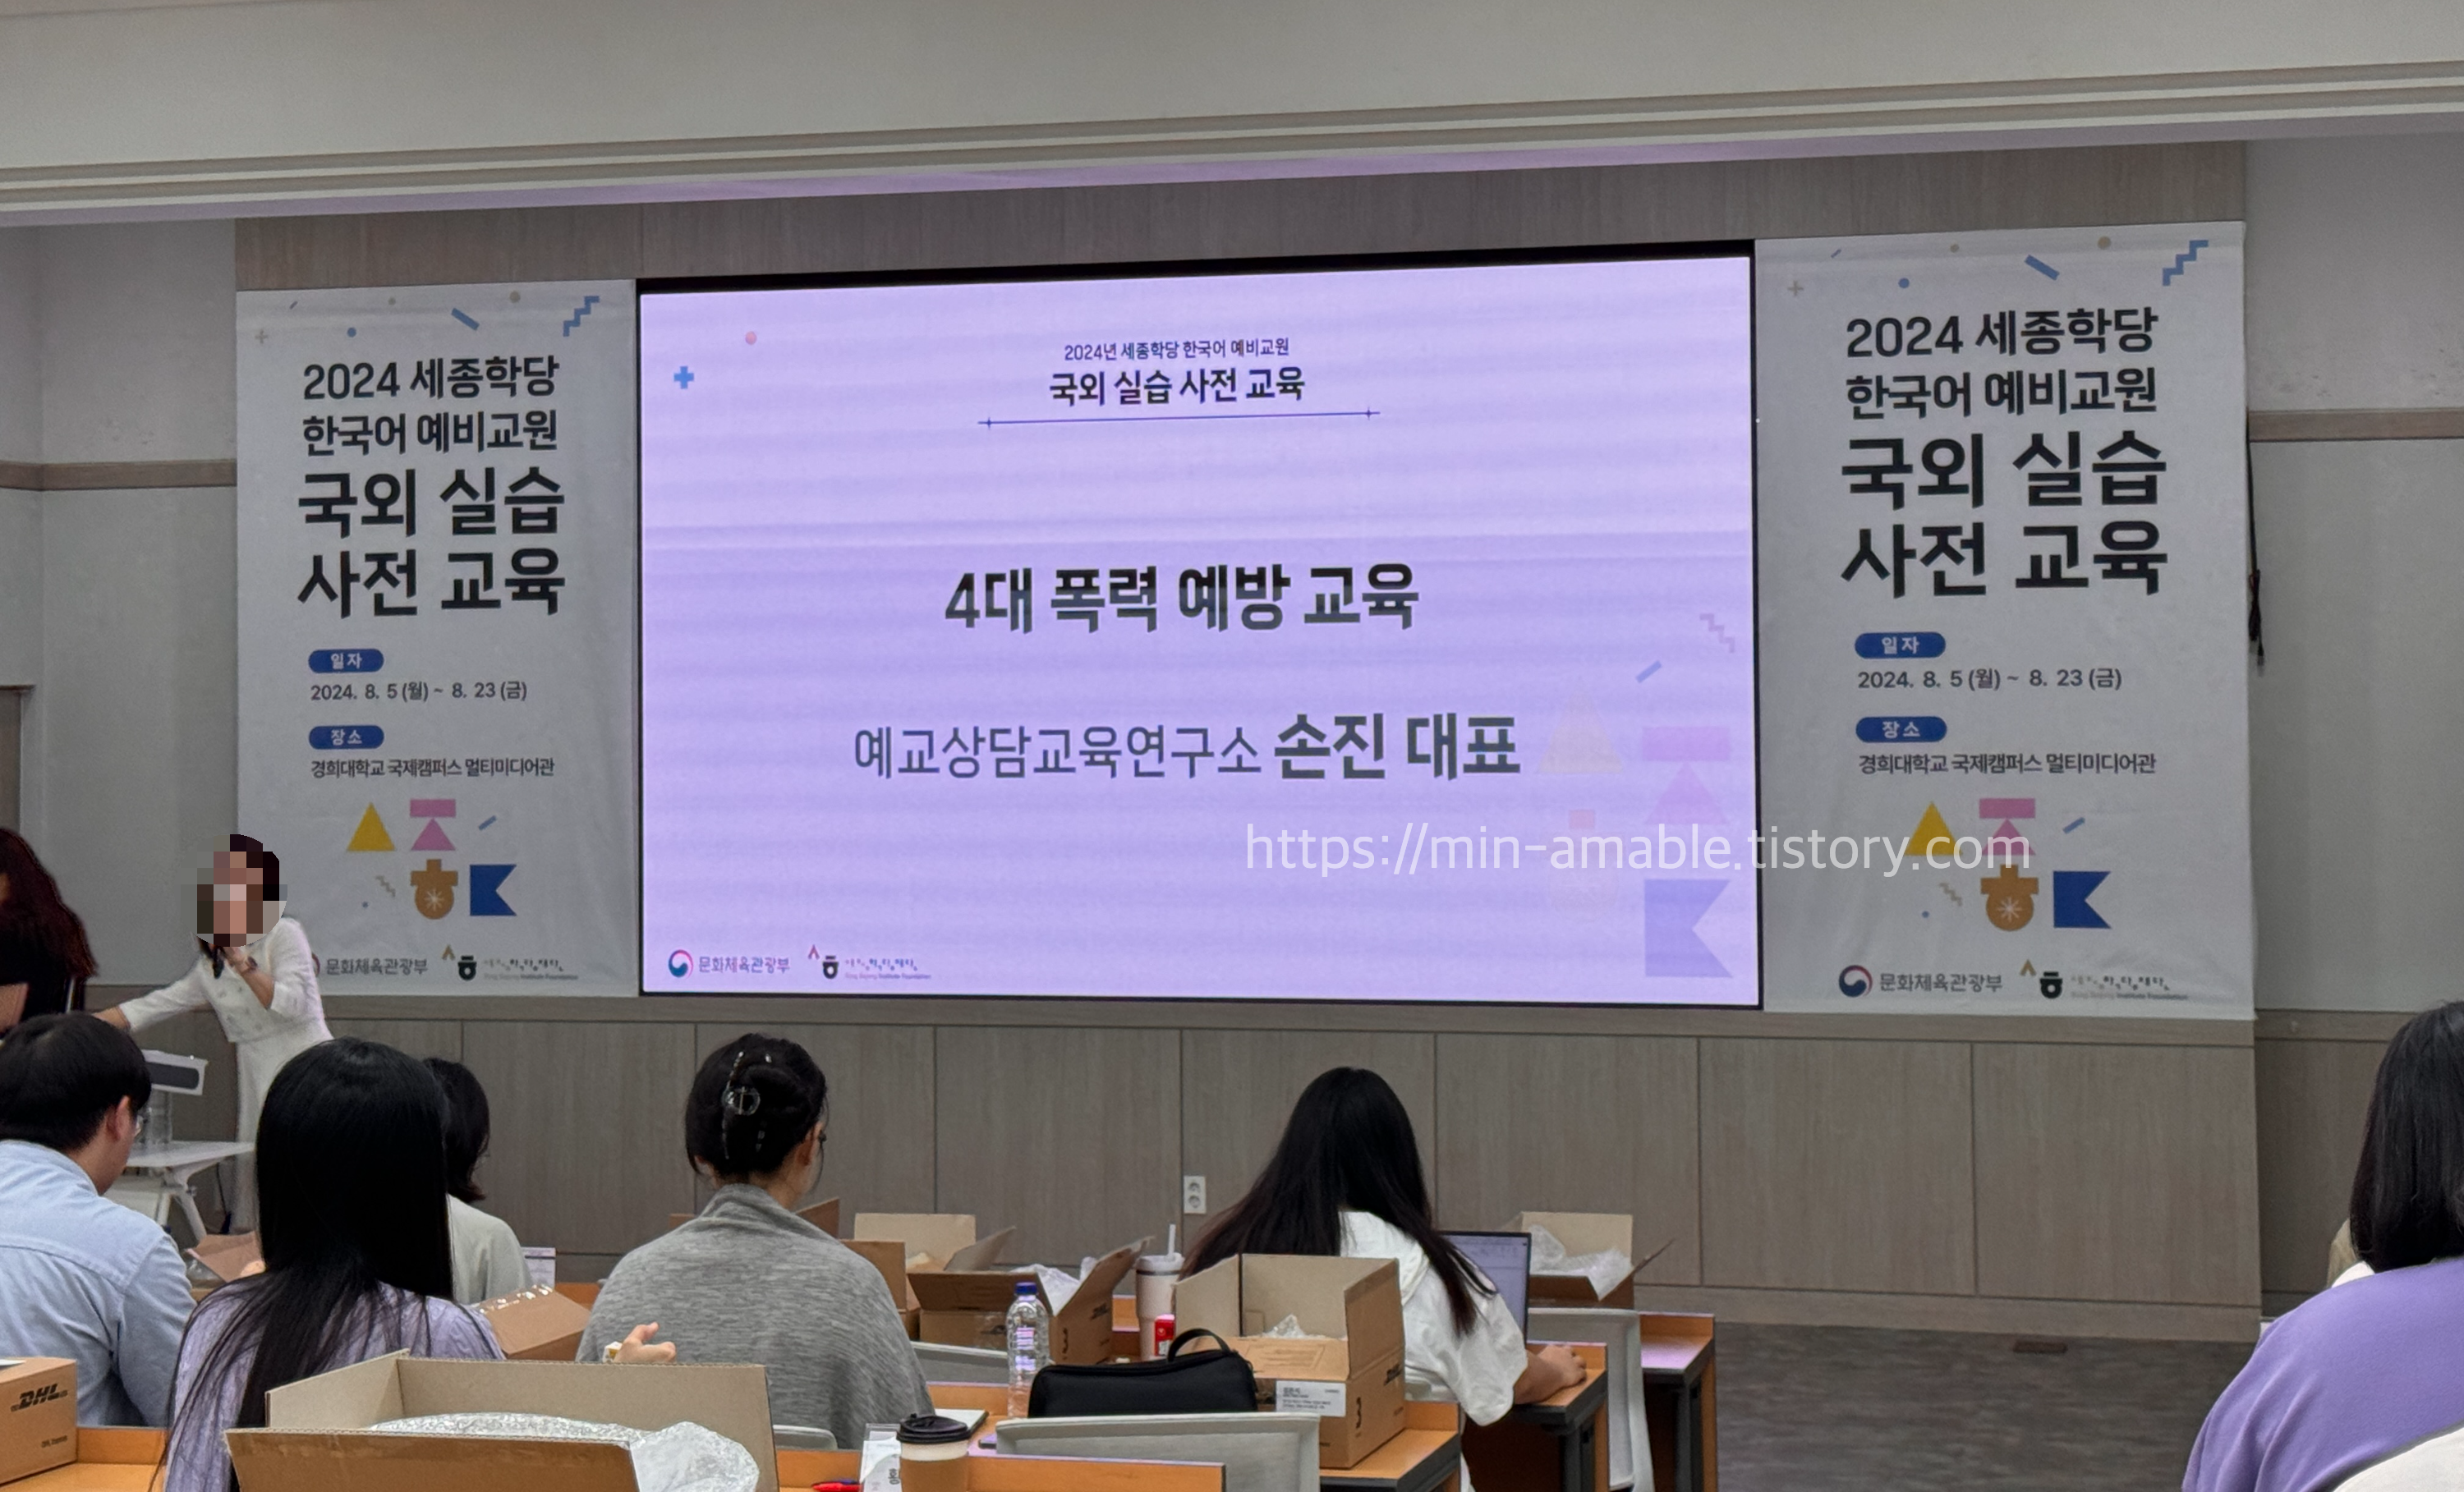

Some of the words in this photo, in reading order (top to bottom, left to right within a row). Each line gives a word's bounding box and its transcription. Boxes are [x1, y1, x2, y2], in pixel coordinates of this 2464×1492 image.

[1064, 343, 1117, 361] 2024년
[1121, 342, 1179, 360] 세종학당
[1183, 339, 1226, 359] 한국어
[1230, 337, 1289, 357] 예비교원
[1846, 315, 1964, 358] 2024
[1975, 307, 2158, 356] 세종학당
[304, 362, 400, 400] 2024
[410, 356, 560, 399] 세종학당
[1050, 371, 1106, 407] 국외
[1114, 369, 1172, 405] 실습
[1179, 367, 1237, 404] 사전
[1246, 366, 1305, 402] 교육
[1846, 372, 1971, 420] 한국어
[1984, 367, 2157, 416] 예비교원
[302, 413, 406, 457] 한국어
[417, 410, 557, 453] 예비교원
[1841, 433, 1984, 511] 국외
[2012, 430, 2167, 507] 실습
[299, 469, 416, 539] 국외
[439, 466, 564, 535] 실습
[1841, 522, 1986, 599] 사전
[2016, 521, 2168, 595] 교육
[297, 549, 417, 618] 사전
[441, 548, 565, 616] 교육
[945, 567, 1032, 634] 4대
[1050, 565, 1159, 633] 폭력
[1178, 563, 1291, 632] 예방
[1304, 562, 1419, 630] 교육
[310, 684, 357, 701] 2024.
[365, 683, 380, 700] 8.
[452, 682, 467, 699] 8.
[1858, 672, 1915, 689] 2024.
[1923, 671, 1941, 689] 8.
[2029, 669, 2048, 687] 8.
[854, 724, 1262, 779] 예교상담교육연구소
[1274, 712, 1386, 779] 손진
[1405, 712, 1521, 780] 대표
[1859, 754, 1948, 775] 경희대학교
[1951, 754, 2043, 774] 국제캠퍼스
[2046, 753, 2156, 774] 멀티미디어관
[310, 760, 385, 779] 경희대학교
[387, 758, 462, 778] 국제캠퍼스
[465, 757, 554, 777] 멀티미디어관
[326, 958, 428, 976] 문화체육관광부
[698, 956, 790, 975] 문화체육관광부
[1879, 972, 2002, 993] 문화체육관광부
[16, 1383, 62, 1410] DHL
